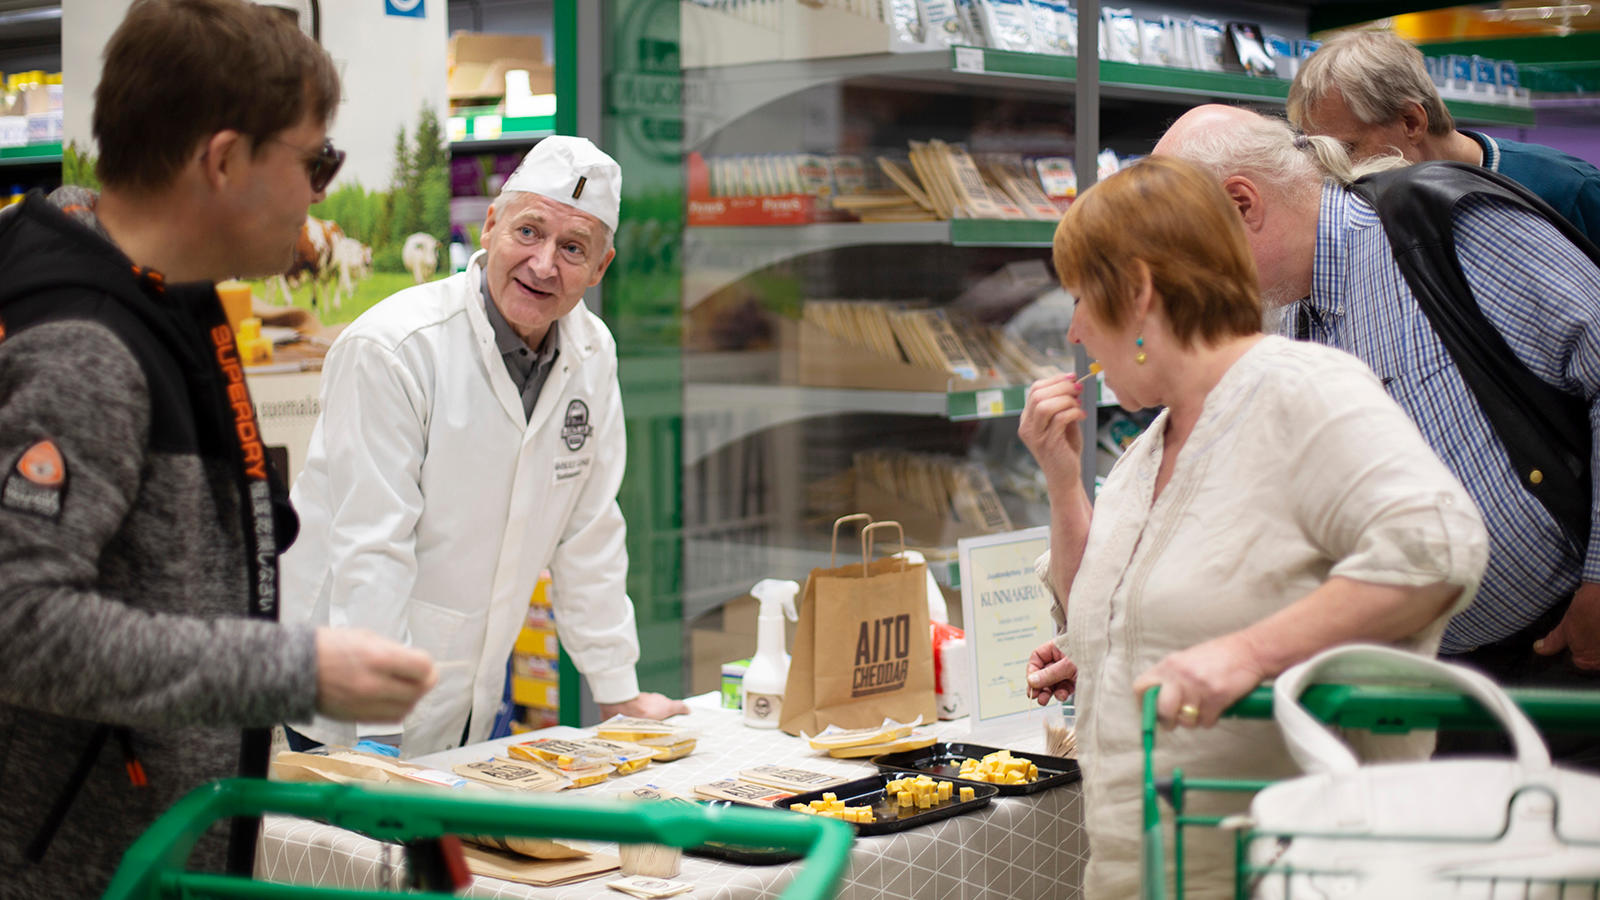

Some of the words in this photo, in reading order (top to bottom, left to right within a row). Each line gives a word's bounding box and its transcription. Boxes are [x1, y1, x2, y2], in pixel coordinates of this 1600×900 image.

[210, 324, 267, 479] SUPERDRY
[260, 397, 321, 418] suomala
[854, 613, 910, 667] AITO
[851, 659, 909, 690] CHEDDAR
